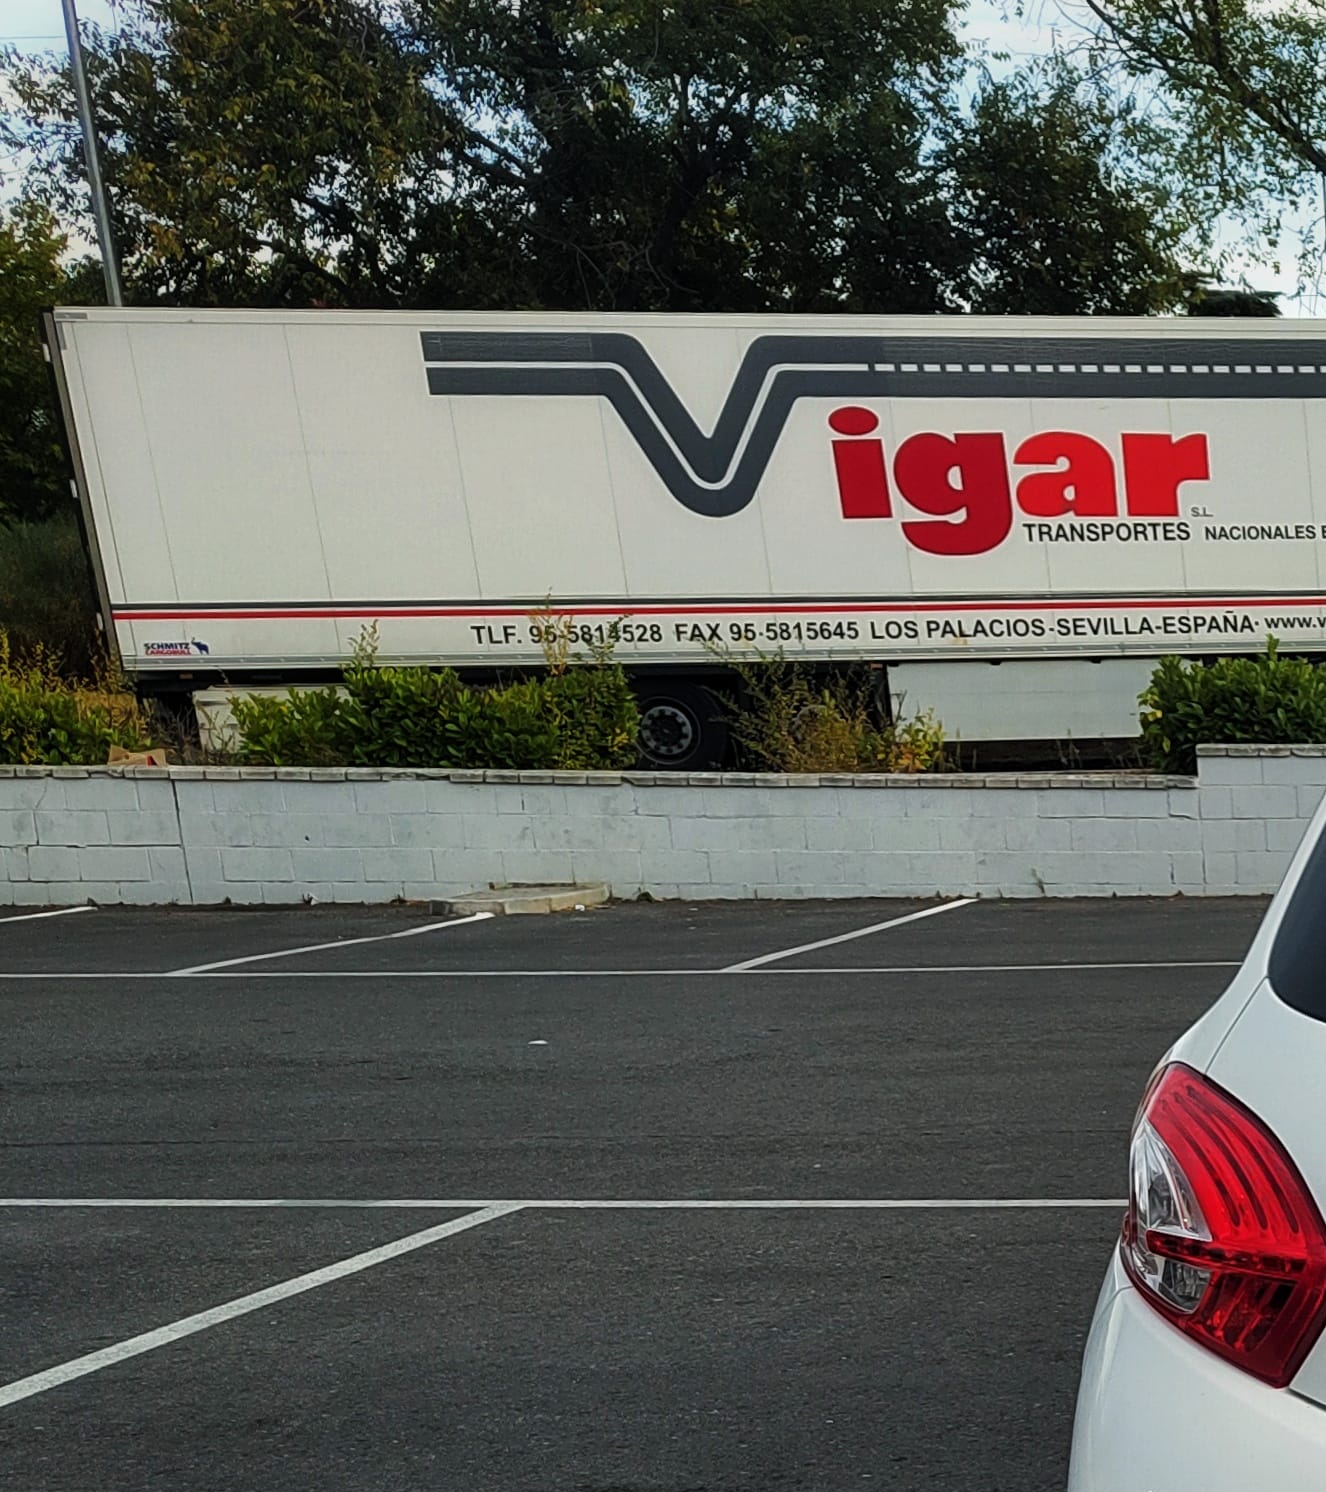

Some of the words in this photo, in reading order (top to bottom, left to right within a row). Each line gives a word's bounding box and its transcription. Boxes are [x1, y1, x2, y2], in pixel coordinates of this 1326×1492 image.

[1022, 522, 1191, 543] TRANSPORTES
[1204, 524, 1317, 541] NACIONALES
[470, 623, 523, 646] TLF.
[528, 622, 664, 645] 955814528
[674, 622, 722, 643] FAX
[869, 619, 919, 640] LOS
[143, 642, 191, 650] SCHMITZ
